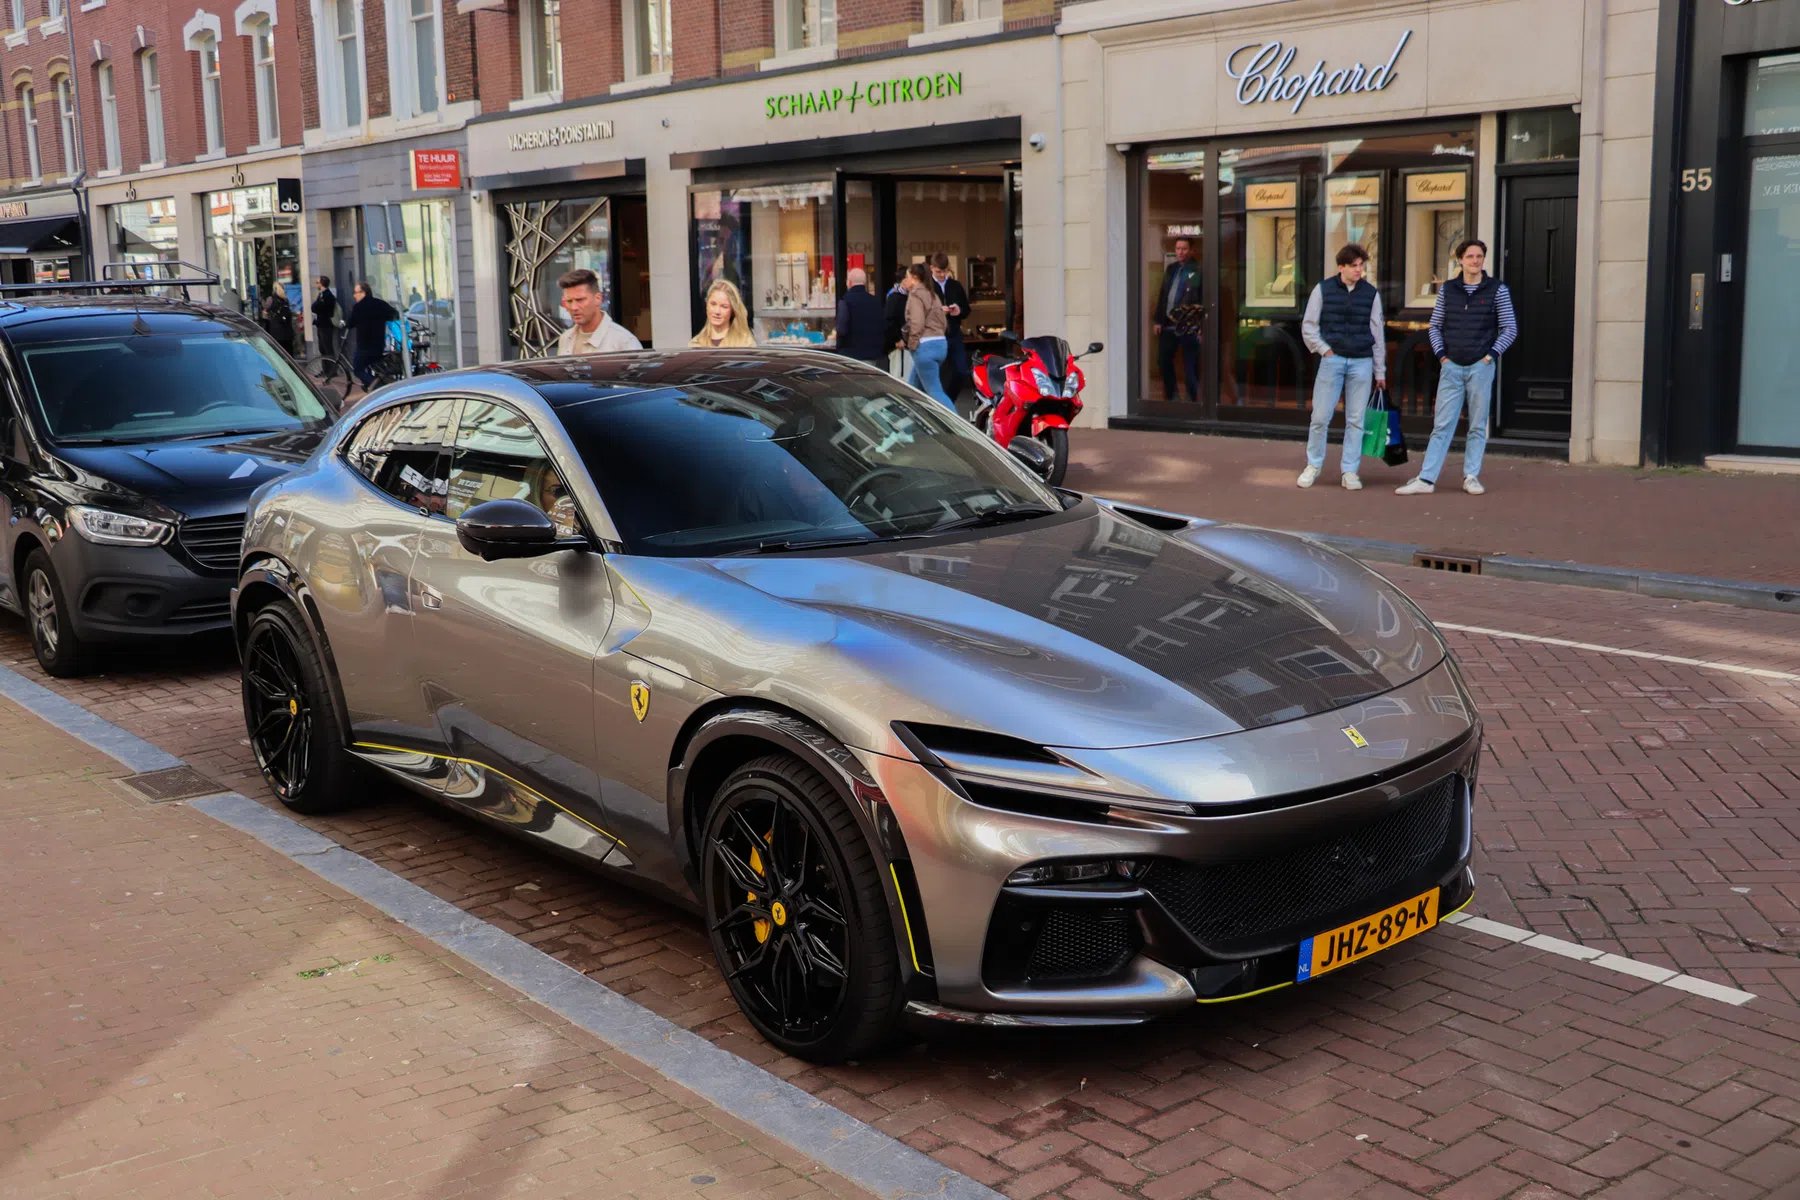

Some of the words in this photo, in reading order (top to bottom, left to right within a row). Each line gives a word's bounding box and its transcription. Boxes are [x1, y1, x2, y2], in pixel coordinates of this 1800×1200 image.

[1225, 30, 1413, 114] Chopard
[765, 87, 843, 119] SCHAAP
[866, 71, 963, 107] CITROEN
[508, 129, 551, 152] VACHERON
[560, 120, 614, 145] CONSTANTIN
[417, 153, 430, 163] TE
[431, 153, 456, 163] HUUR
[1416, 177, 1456, 195] Chopard
[1681, 167, 1713, 192] 55
[281, 197, 300, 213] alo
[1253, 187, 1287, 203] Chopard
[1320, 896, 1431, 968] JHZ-89-K
[1297, 963, 1310, 976] NL
